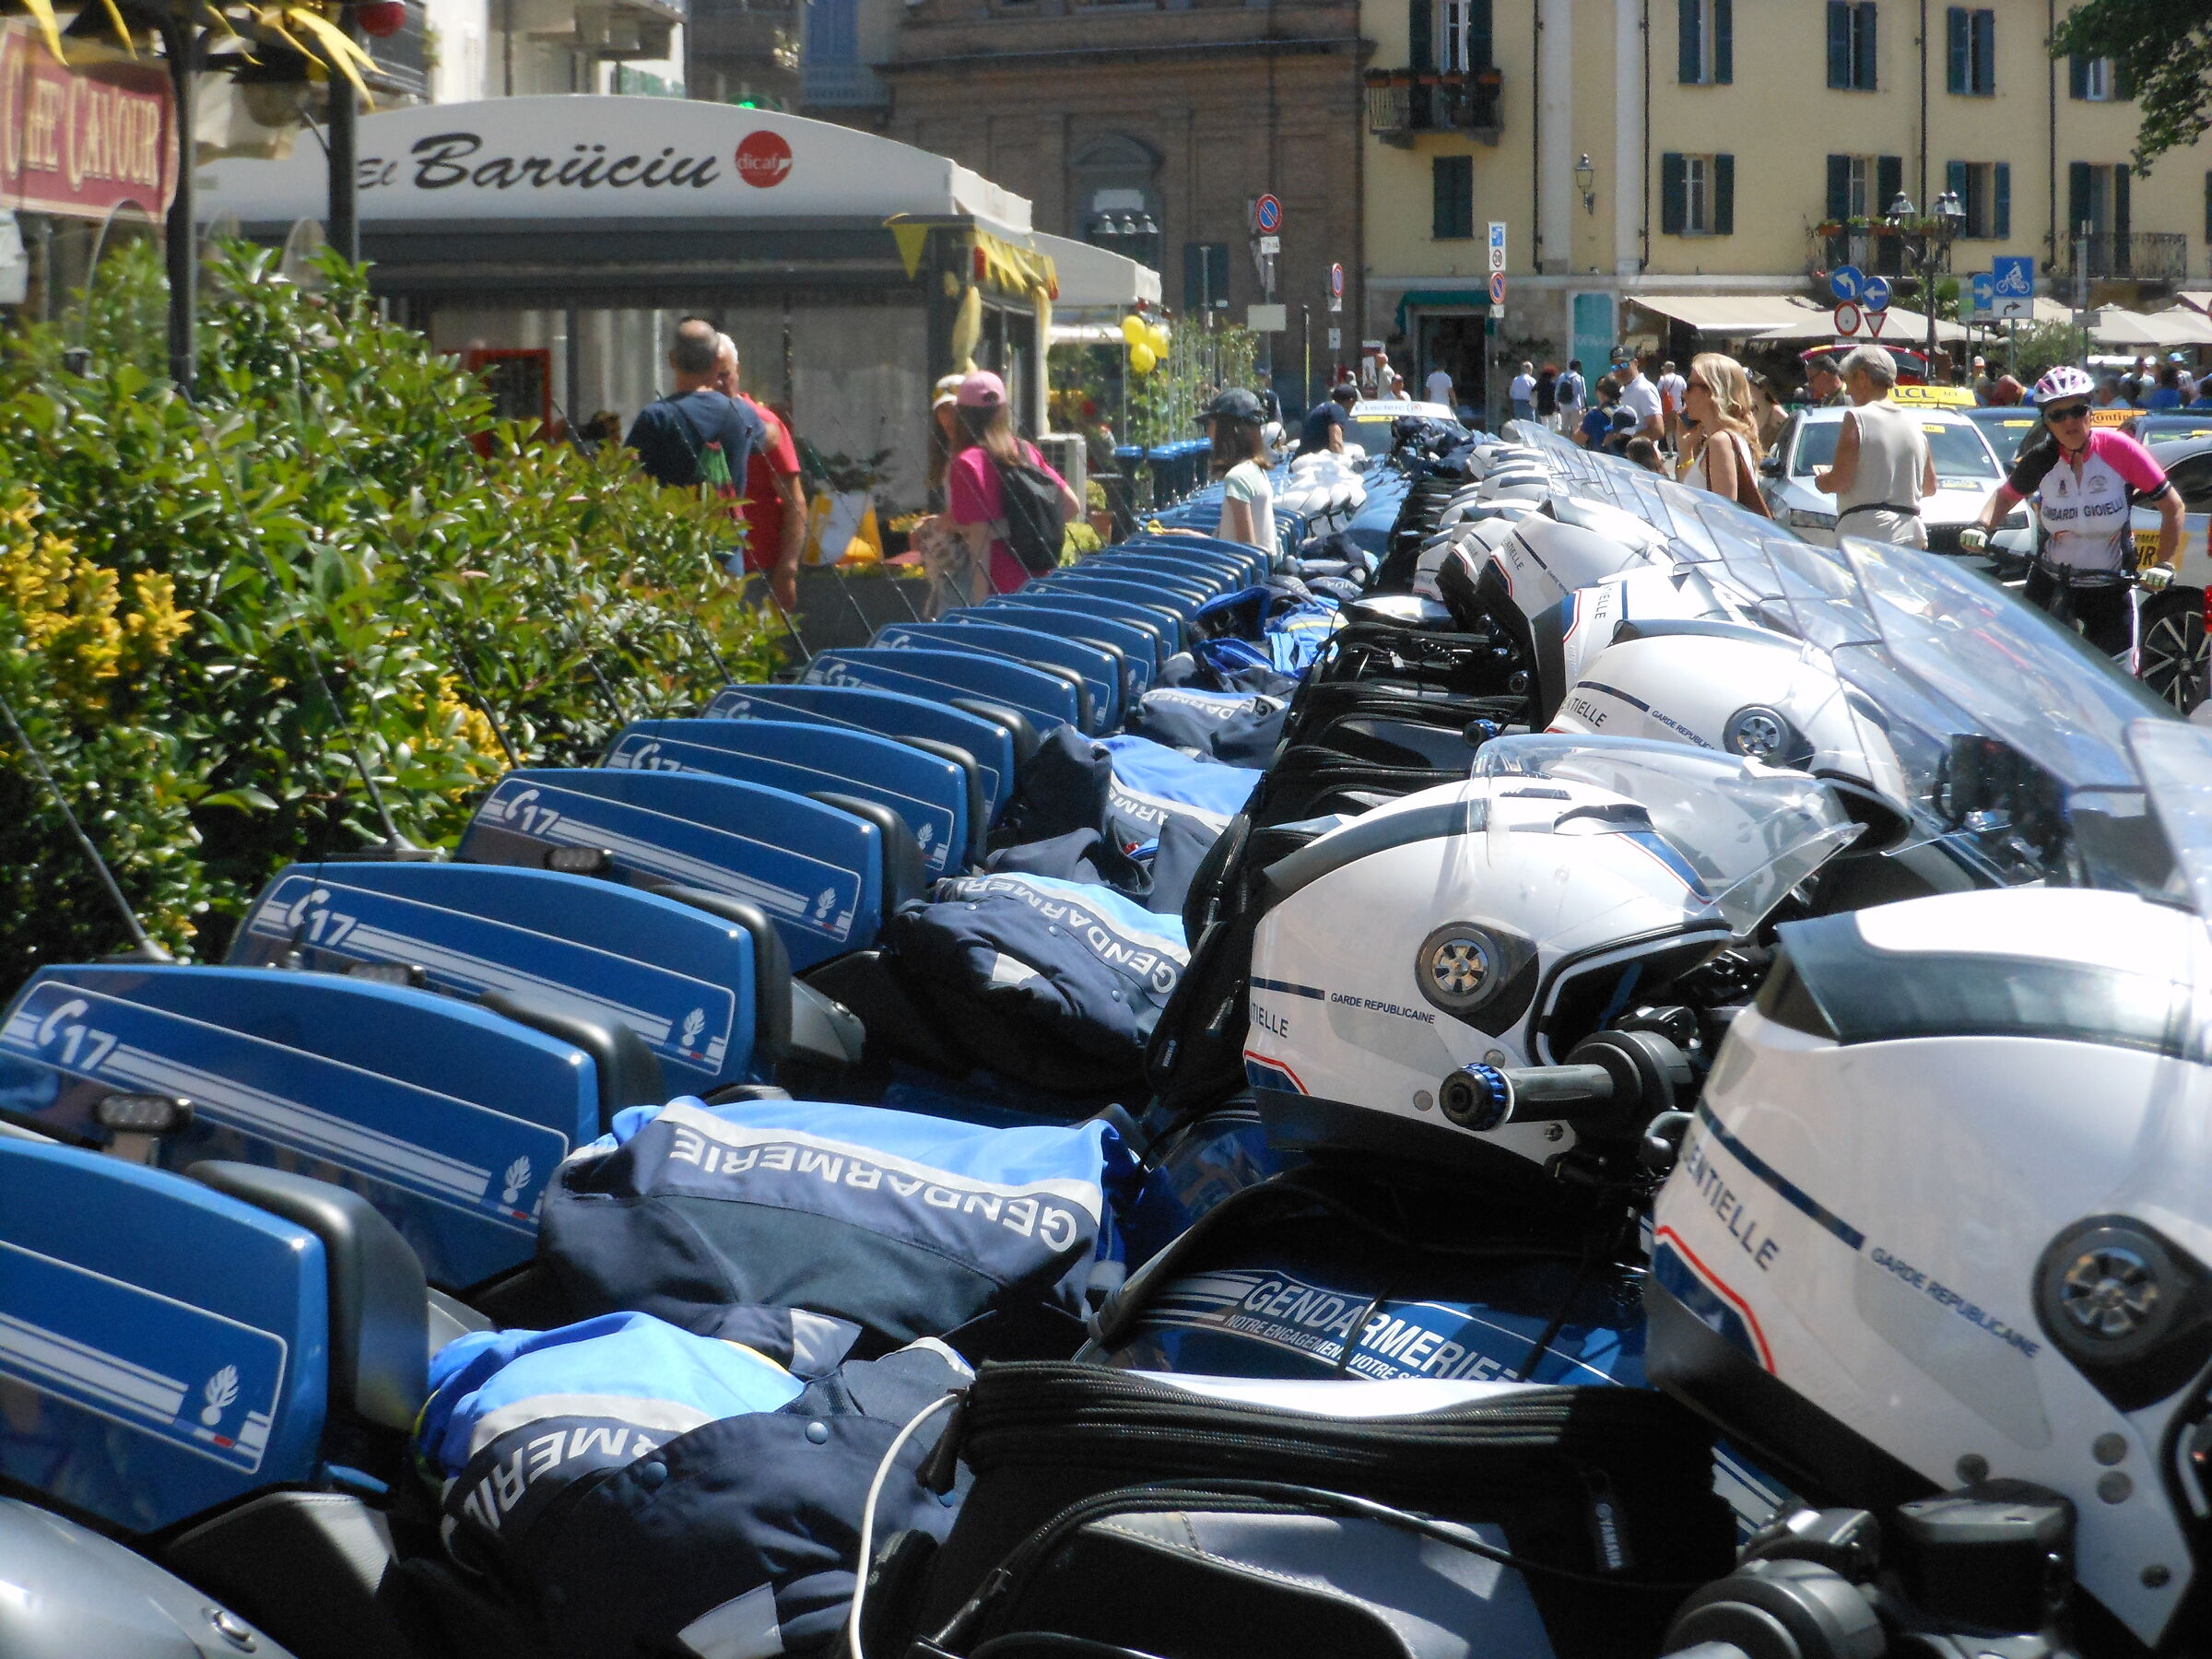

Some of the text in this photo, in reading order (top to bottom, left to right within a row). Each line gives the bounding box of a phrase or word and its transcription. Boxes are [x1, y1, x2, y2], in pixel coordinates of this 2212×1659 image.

[65, 75, 160, 193] CAVOUR
[1894, 388, 1935, 399] LCL
[1652, 709, 1677, 729] GARDE
[522, 805, 560, 836] 17
[309, 908, 358, 946] 17
[1330, 992, 1436, 1025] GARDE REPUBLICAINE
[62, 1023, 118, 1072] 17
[669, 1126, 1078, 1253] GENDARMERIE
[1870, 1246, 2041, 1360] GARDE REPUBLICAINE
[1224, 1313, 1266, 1336] NOTRE
[1349, 1351, 1399, 1380] VOTRE
